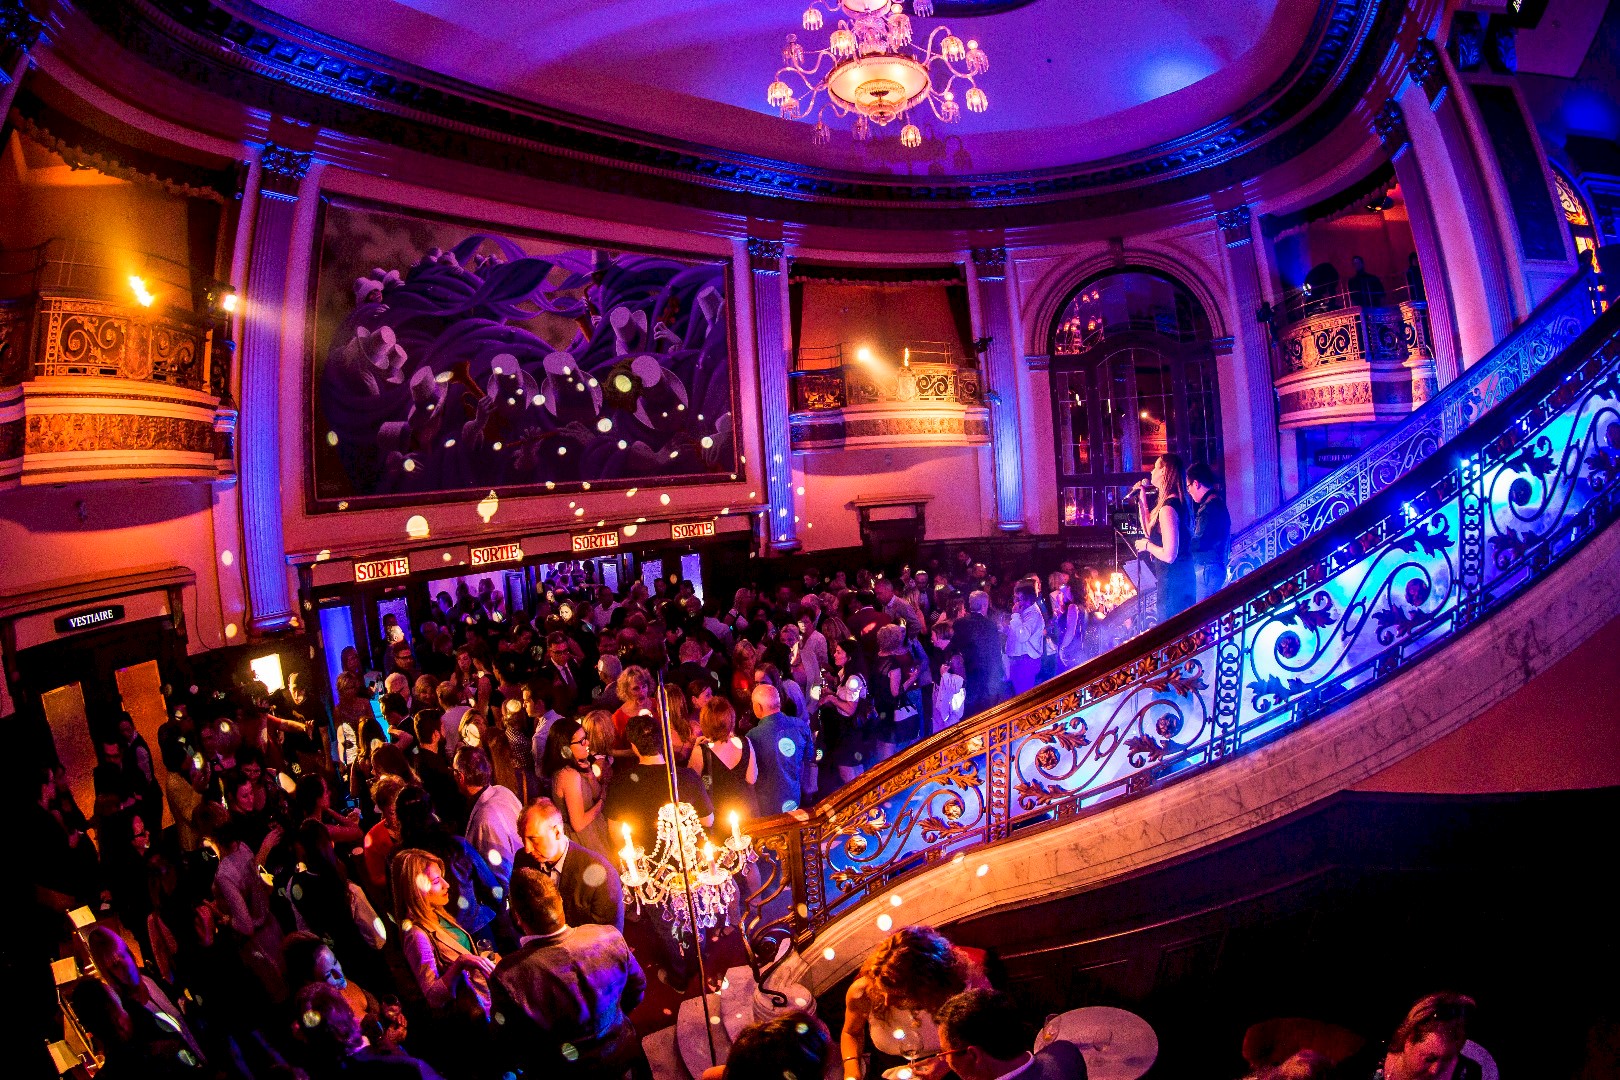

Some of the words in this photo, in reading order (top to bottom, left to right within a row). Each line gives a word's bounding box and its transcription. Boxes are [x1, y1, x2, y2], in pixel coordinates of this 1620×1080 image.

[673, 522, 713, 537] SORTIE
[574, 533, 616, 549] SORTIE
[473, 544, 520, 563] SORTIE
[357, 559, 408, 580] SORTIE
[70, 610, 113, 627] VESTIAIRE
